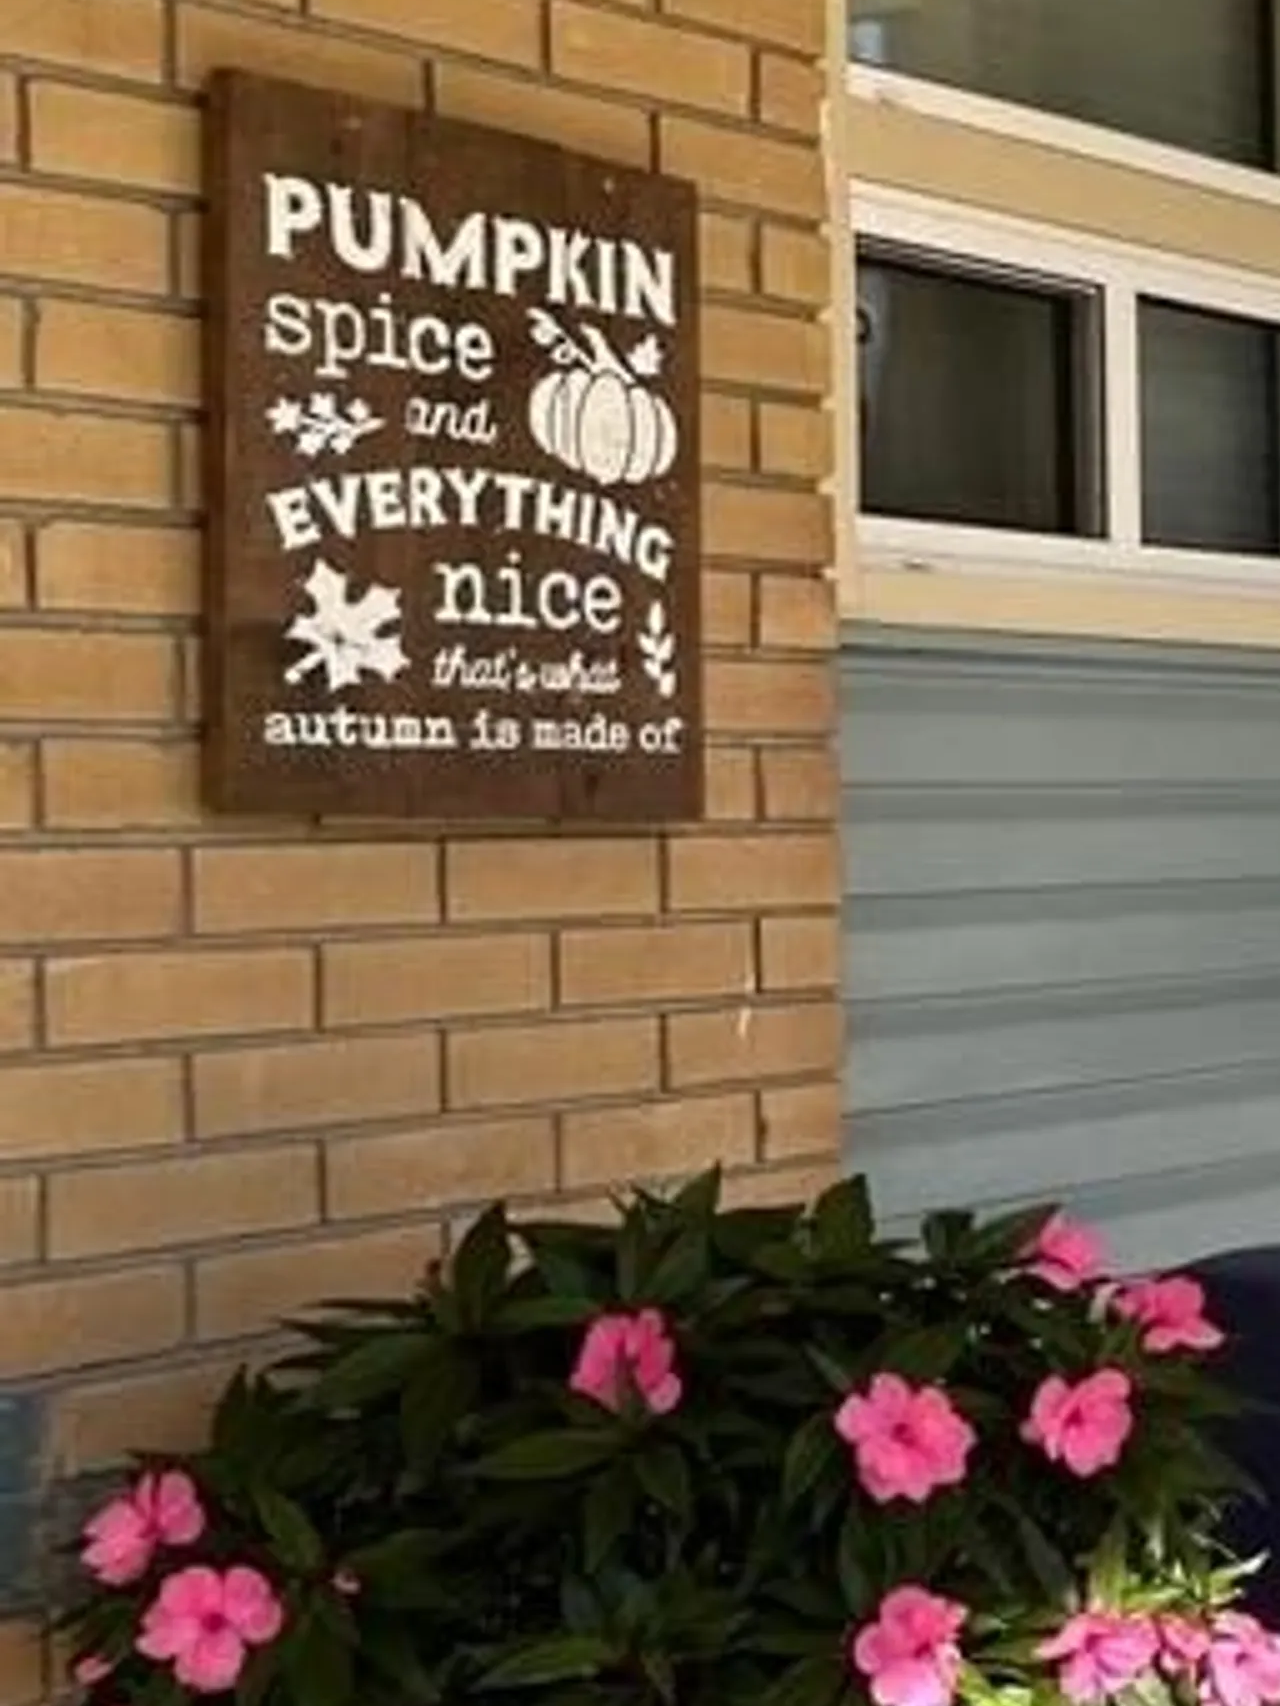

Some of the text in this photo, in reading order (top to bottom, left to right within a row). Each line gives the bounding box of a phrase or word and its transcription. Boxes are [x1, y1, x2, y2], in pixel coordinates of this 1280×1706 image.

[264, 173, 677, 327] PUMPKIN
[264, 293, 495, 379] spice
[405, 397, 497, 445] and
[268, 467, 677, 581] EVERYTHING
[434, 551, 623, 633] nice
[432, 643, 622, 693] that's what
[264, 706, 682, 754] autumn is made of
